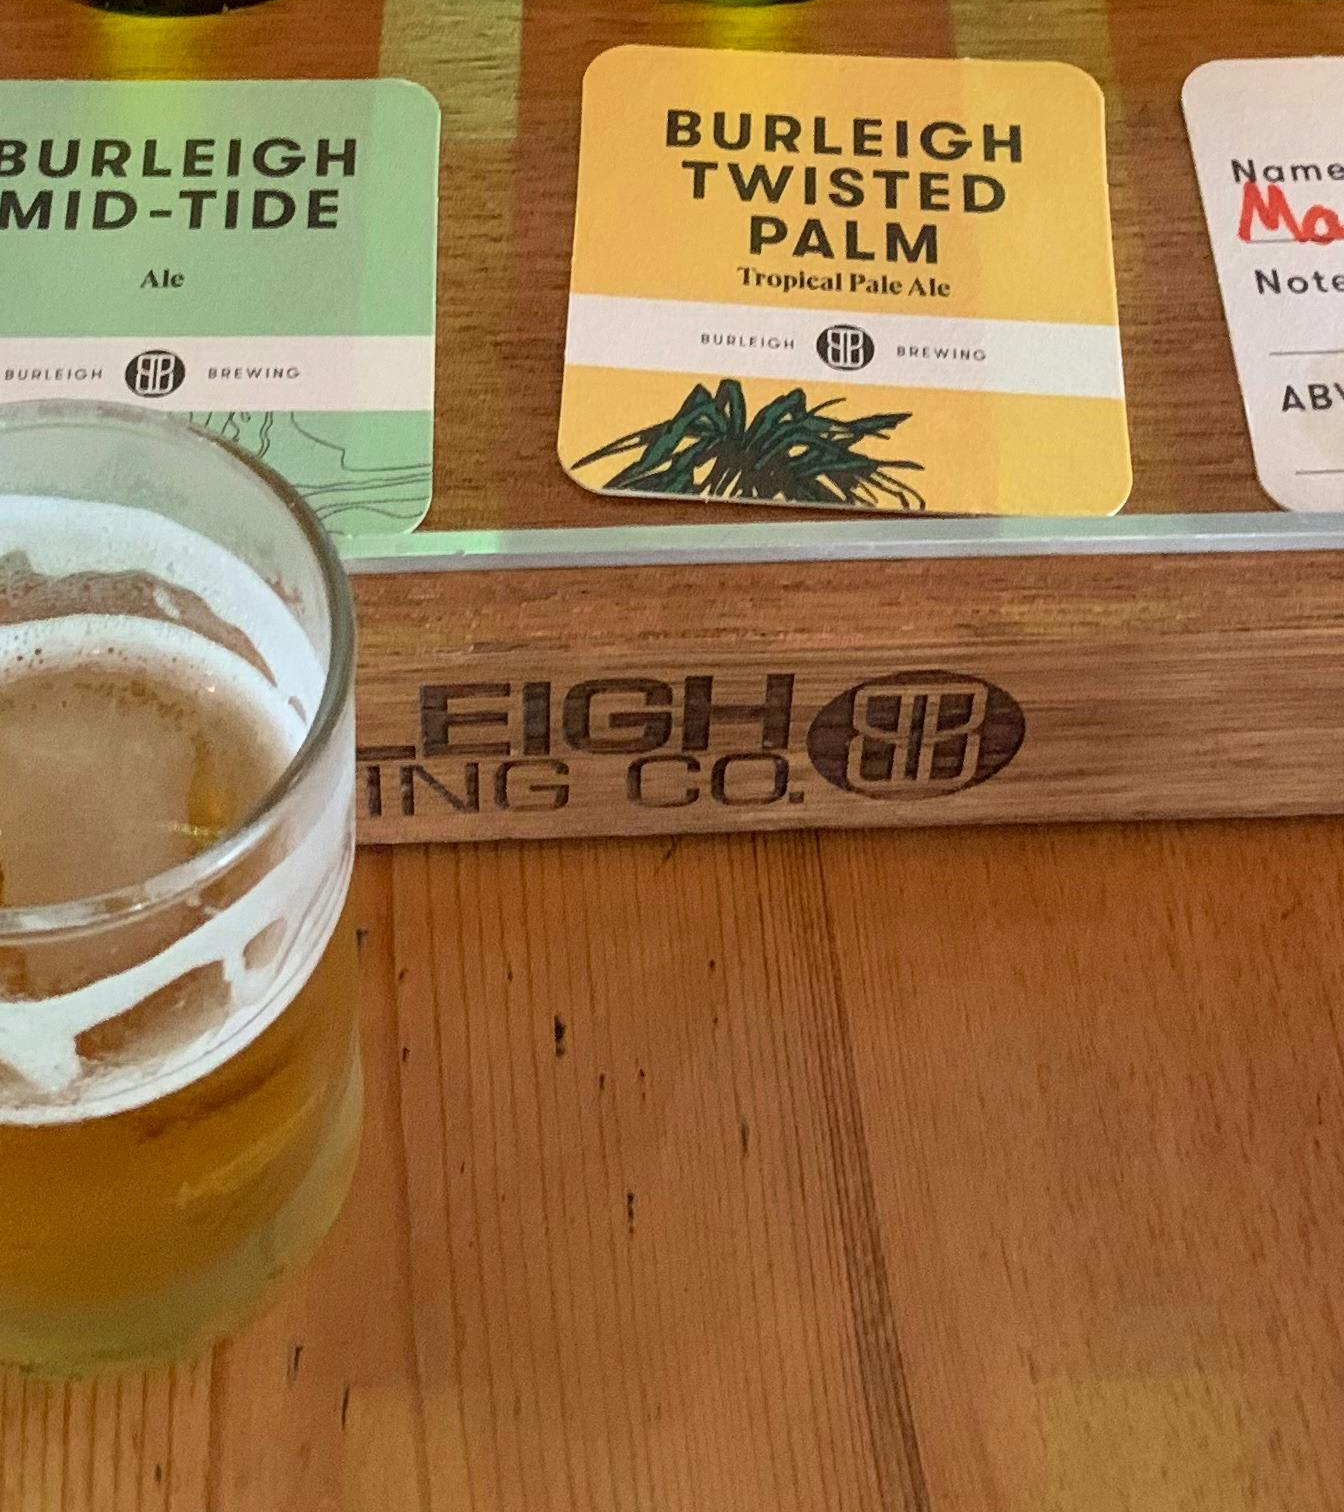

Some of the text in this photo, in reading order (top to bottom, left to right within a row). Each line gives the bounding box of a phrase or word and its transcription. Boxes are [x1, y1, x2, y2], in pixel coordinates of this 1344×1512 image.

[665, 108, 1023, 164] BURLEIGH
[681, 159, 1007, 214] TWISTED
[749, 215, 939, 265] PALM
[139, 268, 186, 289] Ale
[737, 266, 952, 298] Tropical Pale Ale
[699, 332, 796, 350] BURLEIGH
[896, 345, 987, 362] BREWING
[3, 368, 103, 383] BURLEIGH
[207, 365, 301, 380] BREWING
